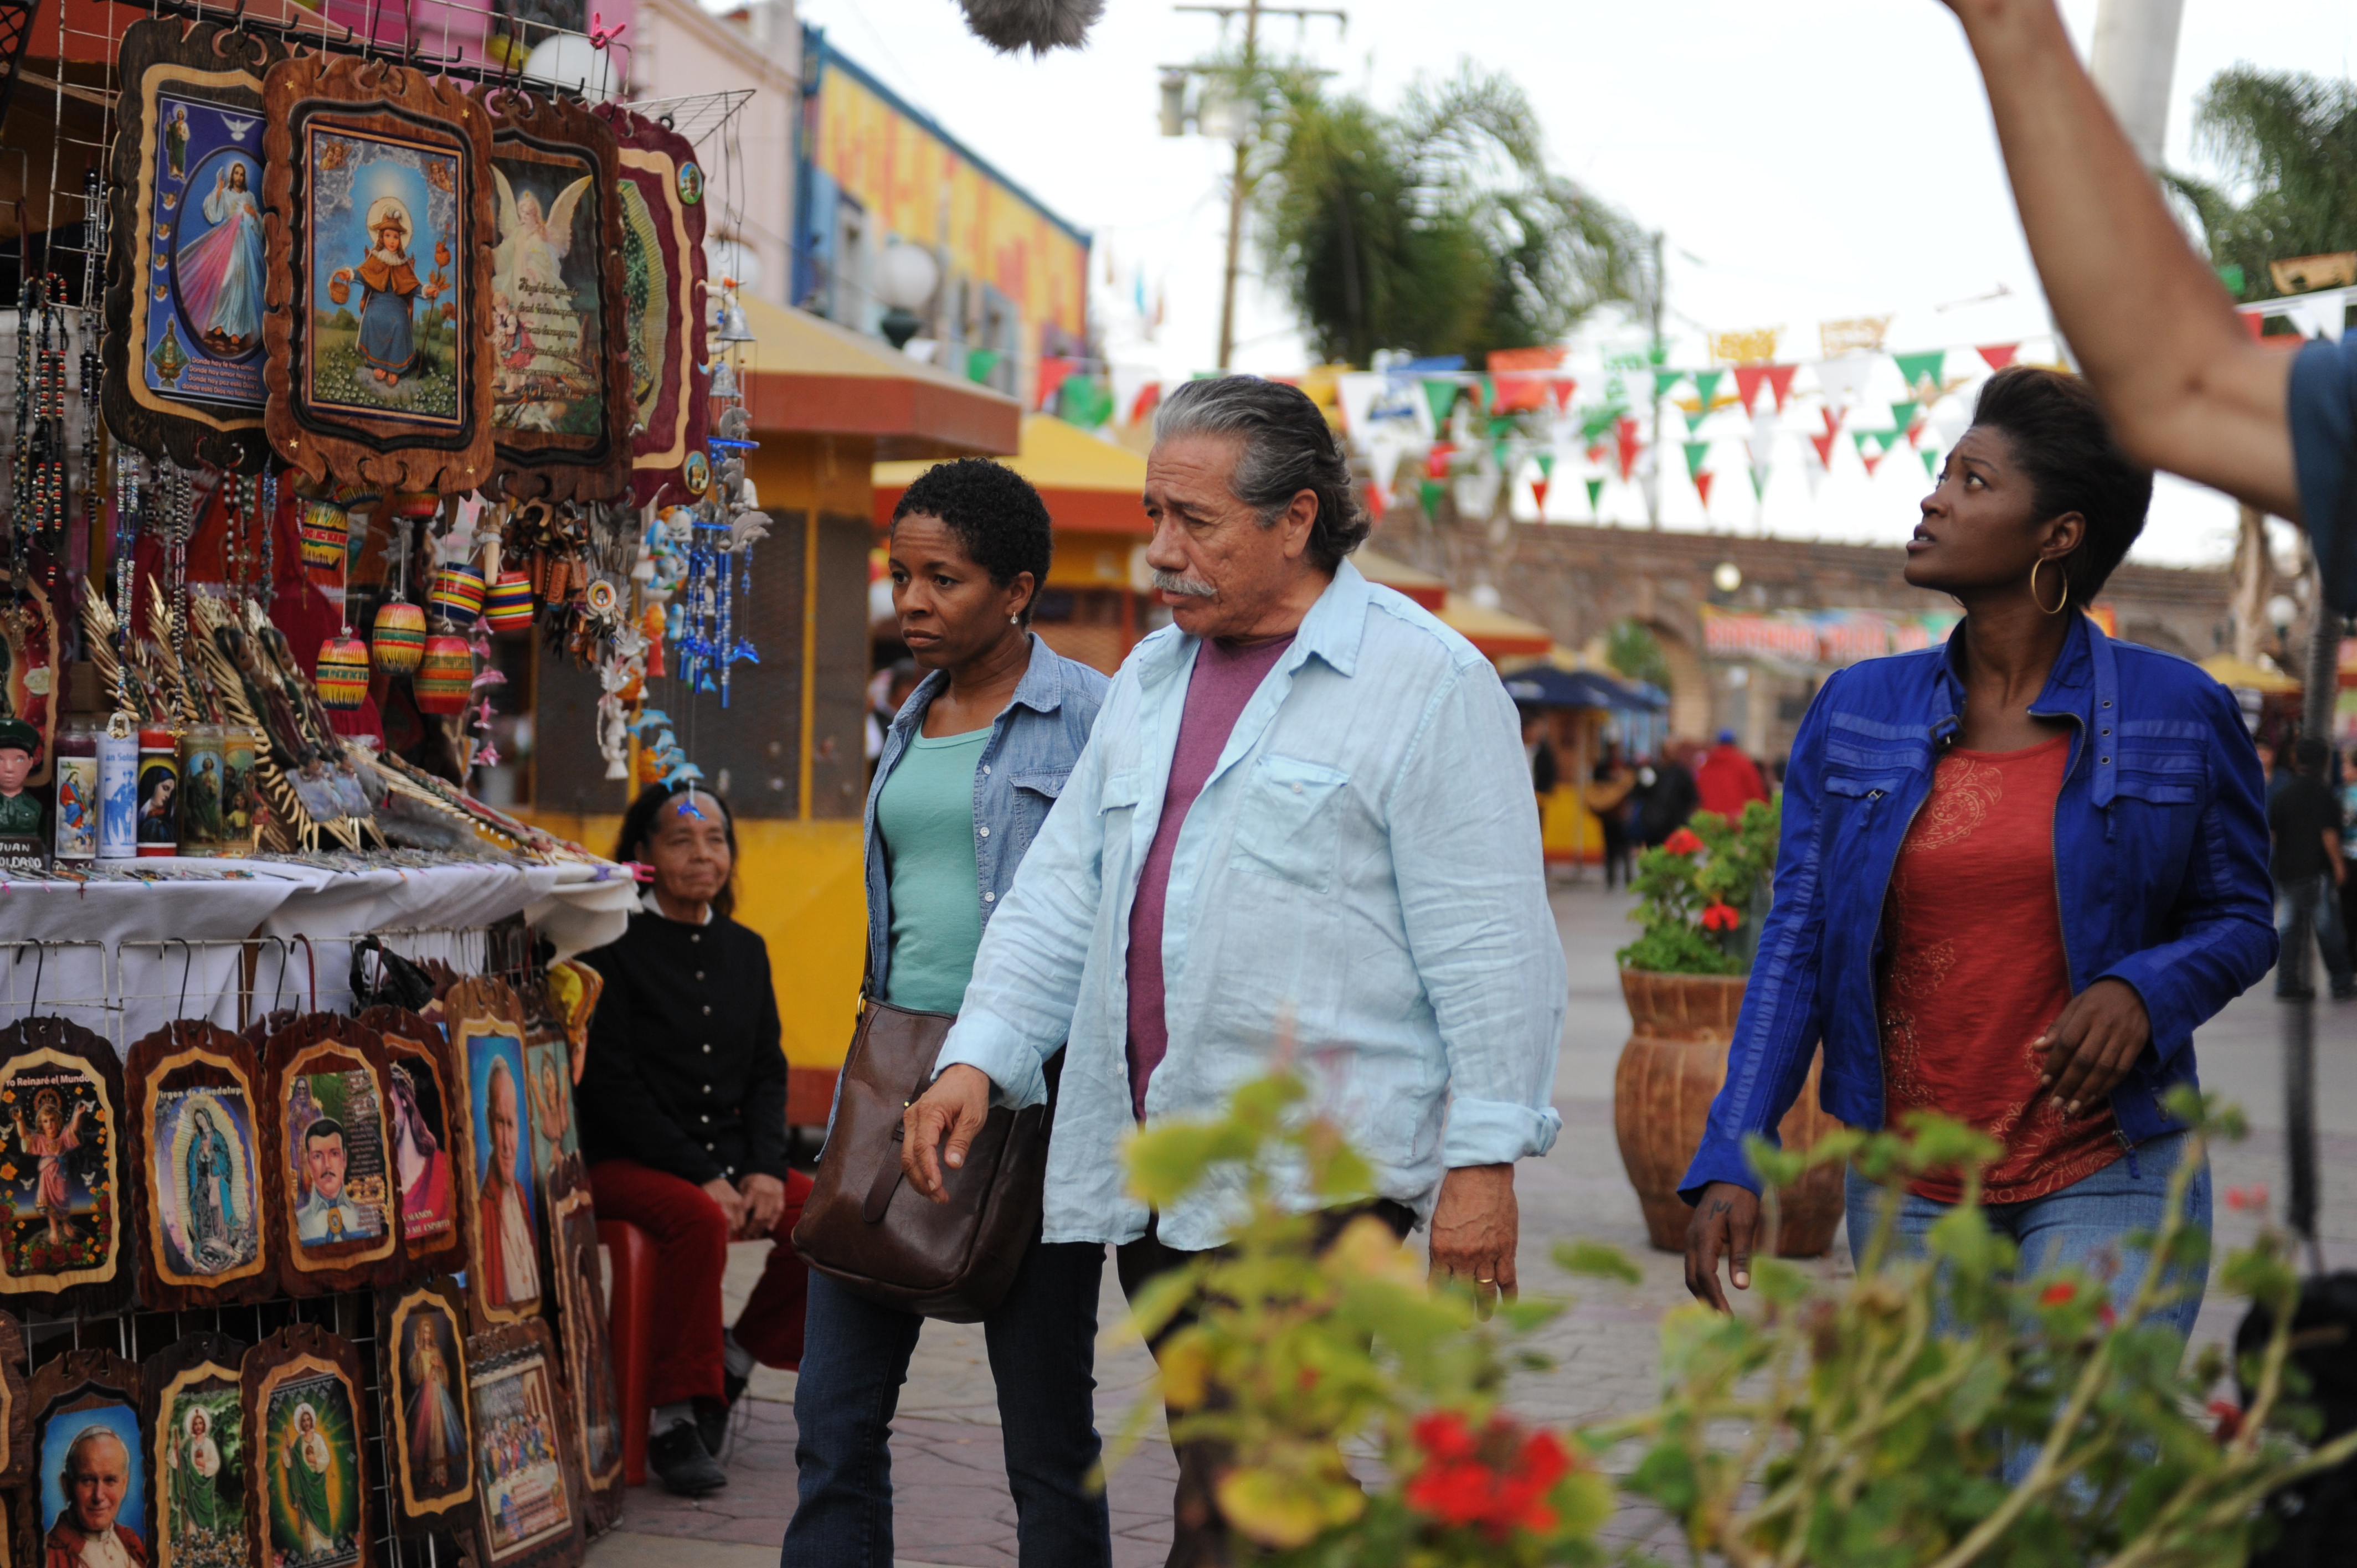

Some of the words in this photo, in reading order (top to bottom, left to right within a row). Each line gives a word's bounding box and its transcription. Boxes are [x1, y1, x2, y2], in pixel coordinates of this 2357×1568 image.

[192, 356, 210, 365] Donde
[211, 359, 222, 368] hay
[189, 365, 208, 373] Donde
[236, 372, 247, 380] hay
[182, 383, 200, 391] donde
[188, 374, 207, 383] Donde
[243, 381, 255, 390] Dios
[0, 856, 42, 869] OLDADO
[17, 1076, 50, 1087] Reinaré
[51, 1076, 58, 1085] el
[60, 1073, 91, 1084] Mundo
[159, 1090, 184, 1100] irgen
[186, 1089, 197, 1097] de
[199, 1085, 244, 1097] Guadalup
